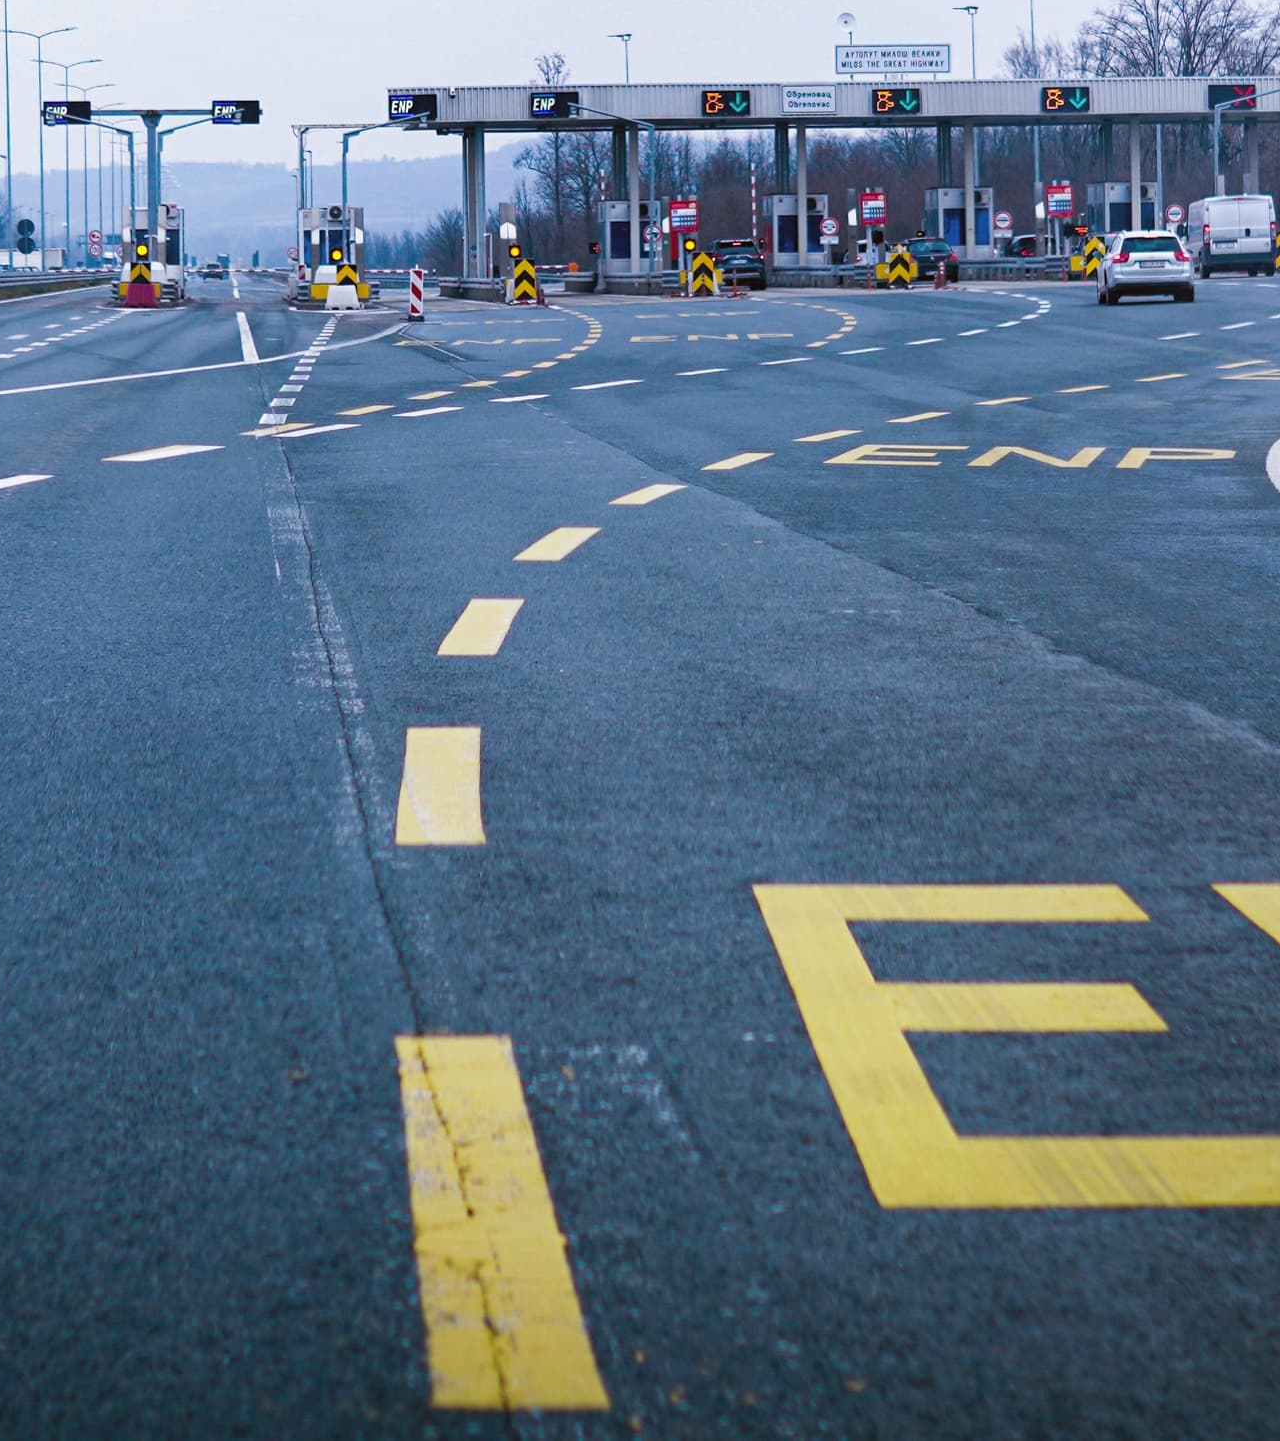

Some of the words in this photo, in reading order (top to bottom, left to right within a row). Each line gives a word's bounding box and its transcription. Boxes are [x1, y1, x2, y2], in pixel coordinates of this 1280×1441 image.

[867, 60, 880, 68] THE
[883, 60, 907, 68] GREAT
[910, 60, 945, 68] HIGHWAY
[786, 90, 832, 99] Обреновац
[391, 99, 414, 114] ENP
[532, 97, 556, 111] ENP
[788, 100, 831, 108] Obrenovac
[824, 444, 1236, 469] ENP
